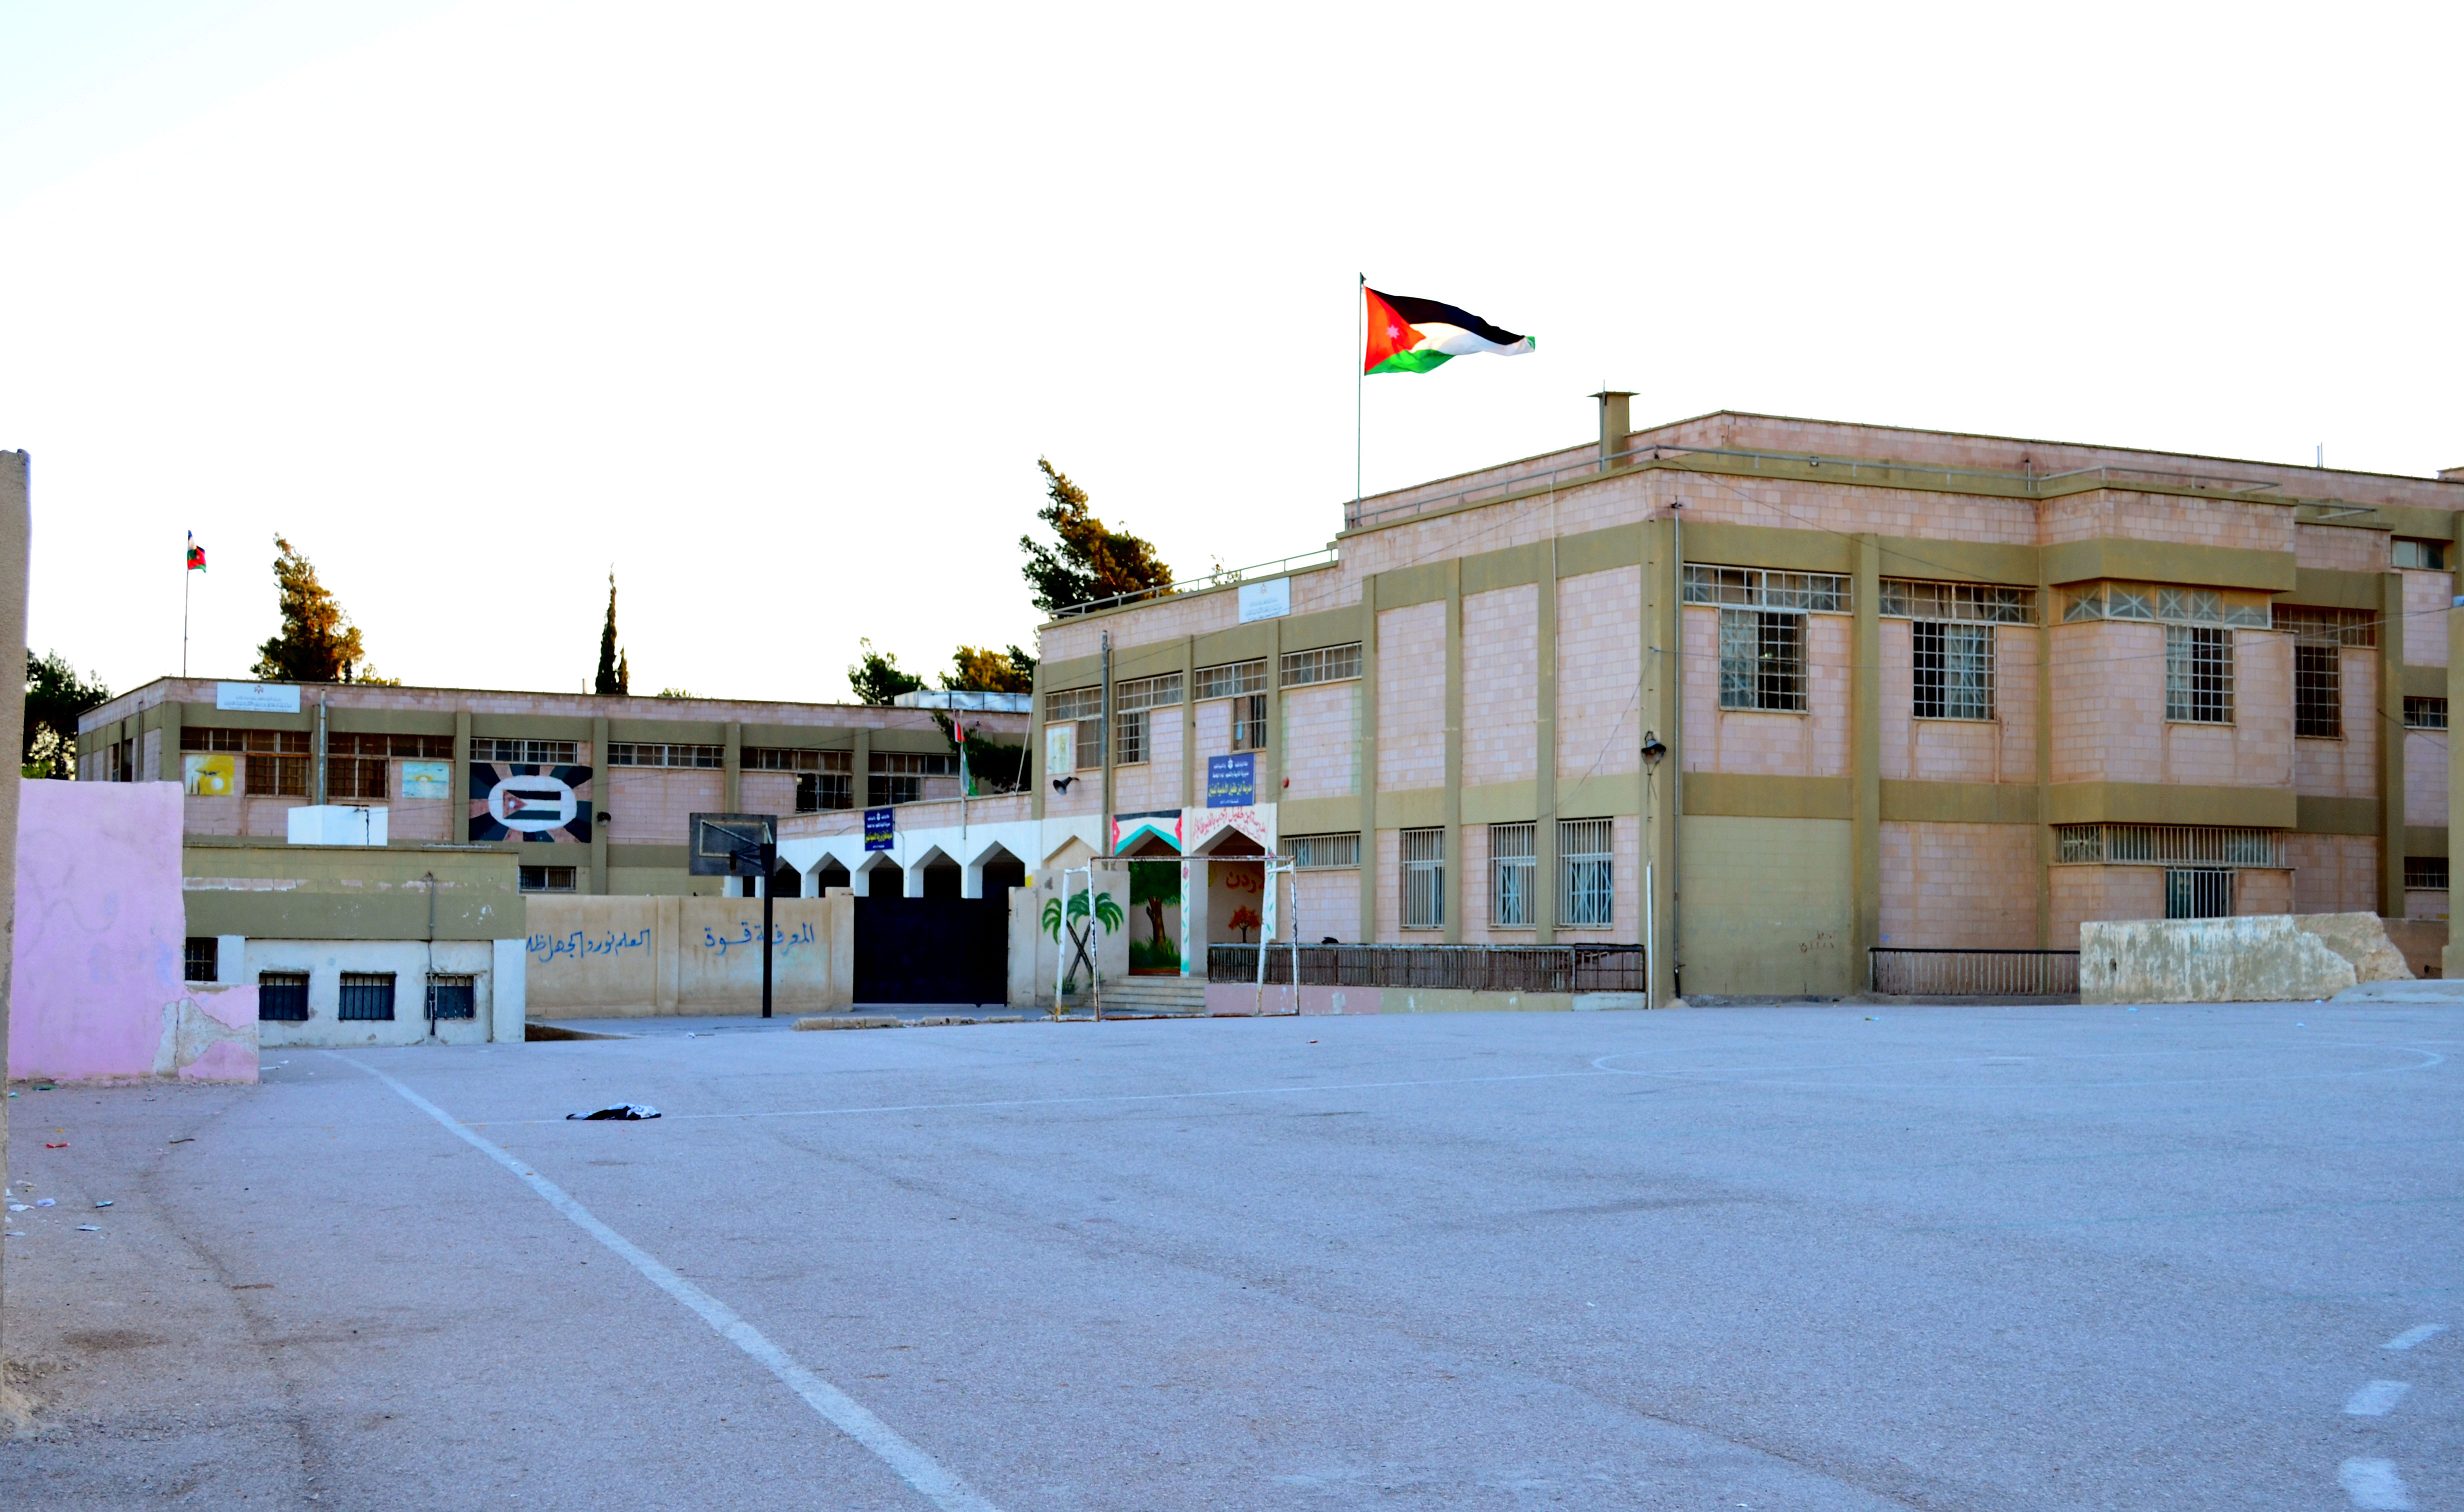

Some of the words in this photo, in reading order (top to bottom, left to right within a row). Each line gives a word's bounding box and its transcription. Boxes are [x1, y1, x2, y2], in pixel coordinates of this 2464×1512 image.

[614, 928, 650, 956] العلم
[704, 921, 752, 956] قوة
[754, 922, 816, 956] المعرفة
